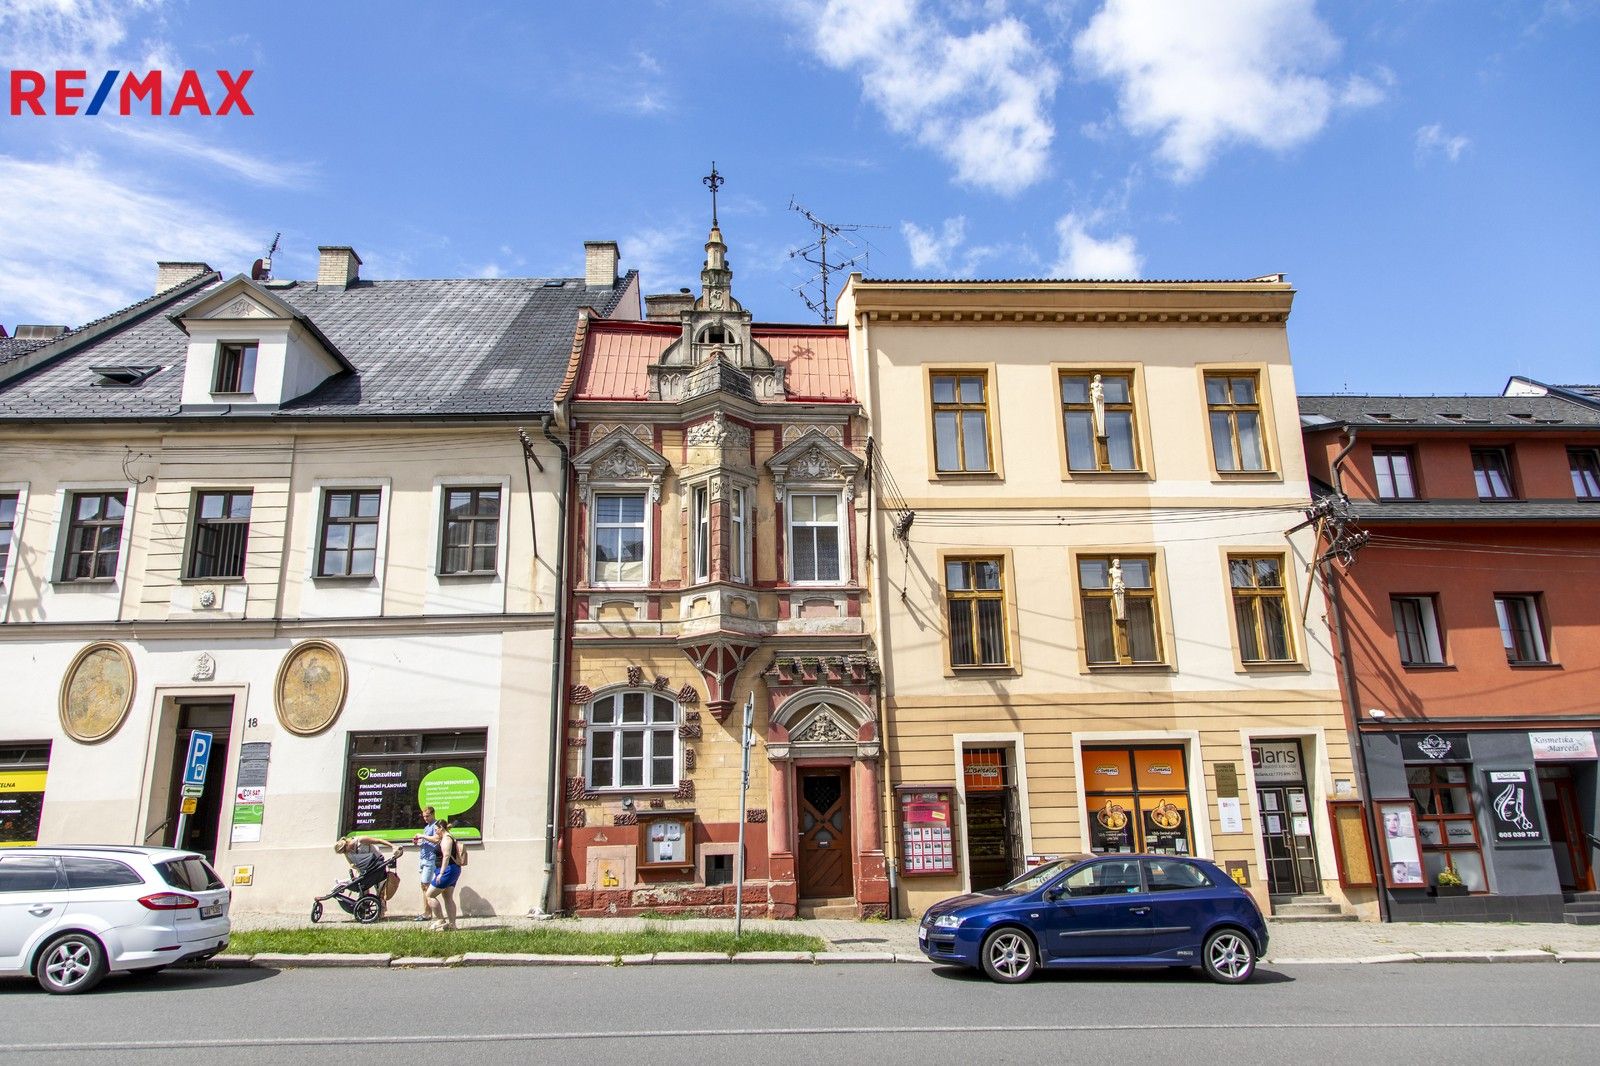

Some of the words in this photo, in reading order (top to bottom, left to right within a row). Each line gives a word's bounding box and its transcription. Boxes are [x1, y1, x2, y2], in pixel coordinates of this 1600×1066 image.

[248, 718, 258, 728] 18
[1534, 736, 1574, 744] Kosmetika
[192, 738, 206, 767] P
